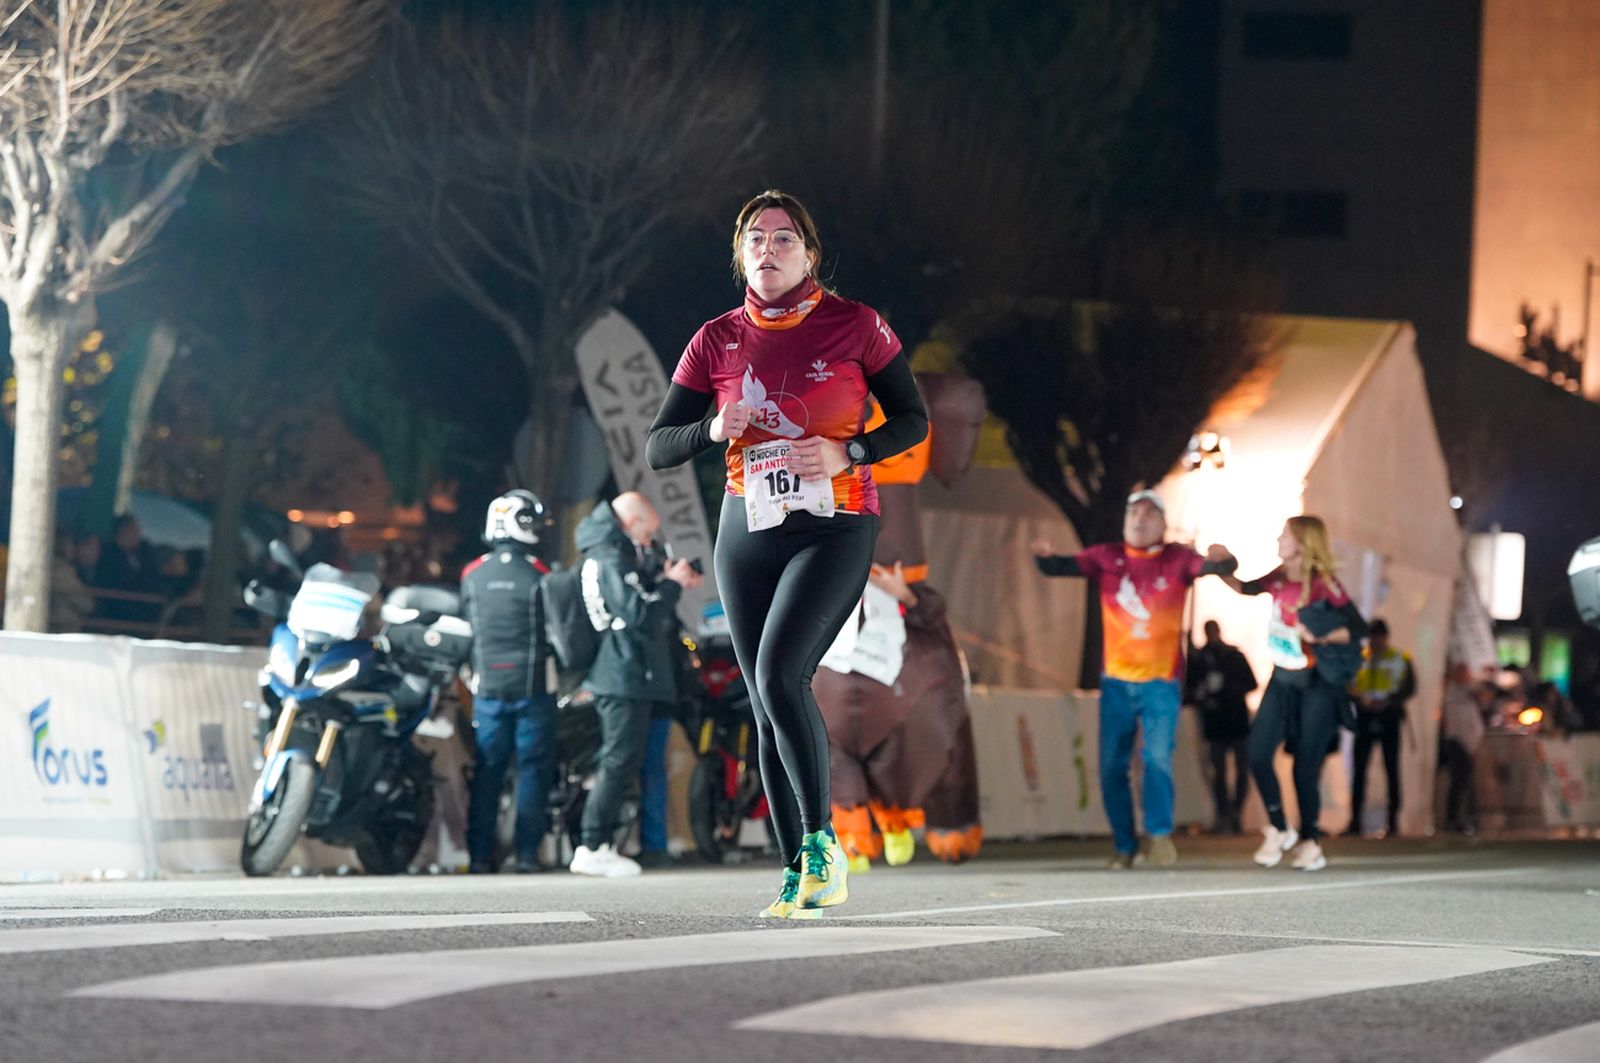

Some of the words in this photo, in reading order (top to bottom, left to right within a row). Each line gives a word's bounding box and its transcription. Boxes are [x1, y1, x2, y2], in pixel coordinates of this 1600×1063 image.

[755, 407, 780, 429] 43
[623, 349, 703, 541] JAPASA
[757, 448, 779, 461] NOCHE
[780, 448, 791, 456] D
[750, 463, 763, 474] SAN
[764, 457, 793, 469] ANTÓ
